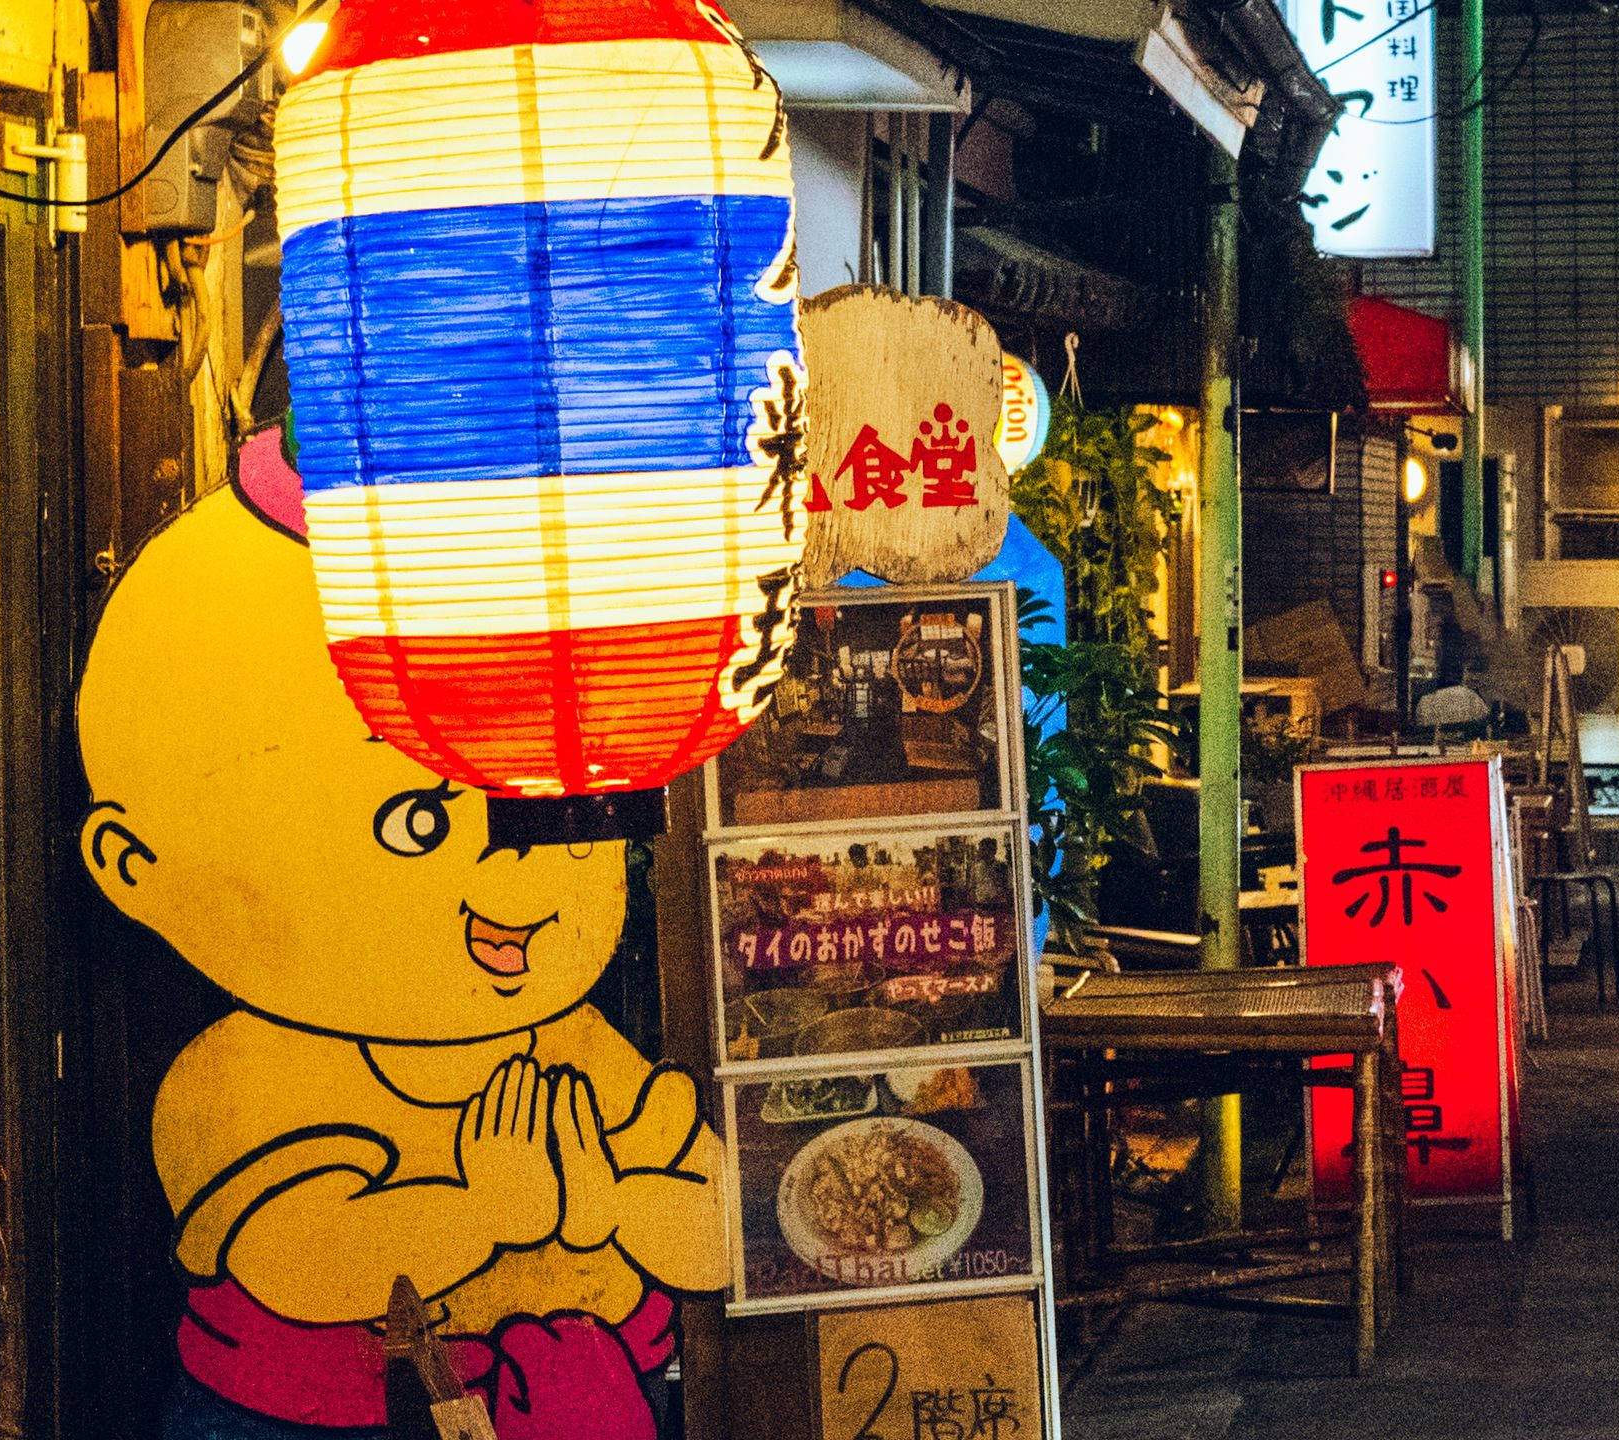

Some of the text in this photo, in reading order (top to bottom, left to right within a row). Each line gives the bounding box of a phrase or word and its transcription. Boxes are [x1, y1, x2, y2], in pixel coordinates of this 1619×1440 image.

[737, 912, 997, 969] タイのおかずのせご飯
